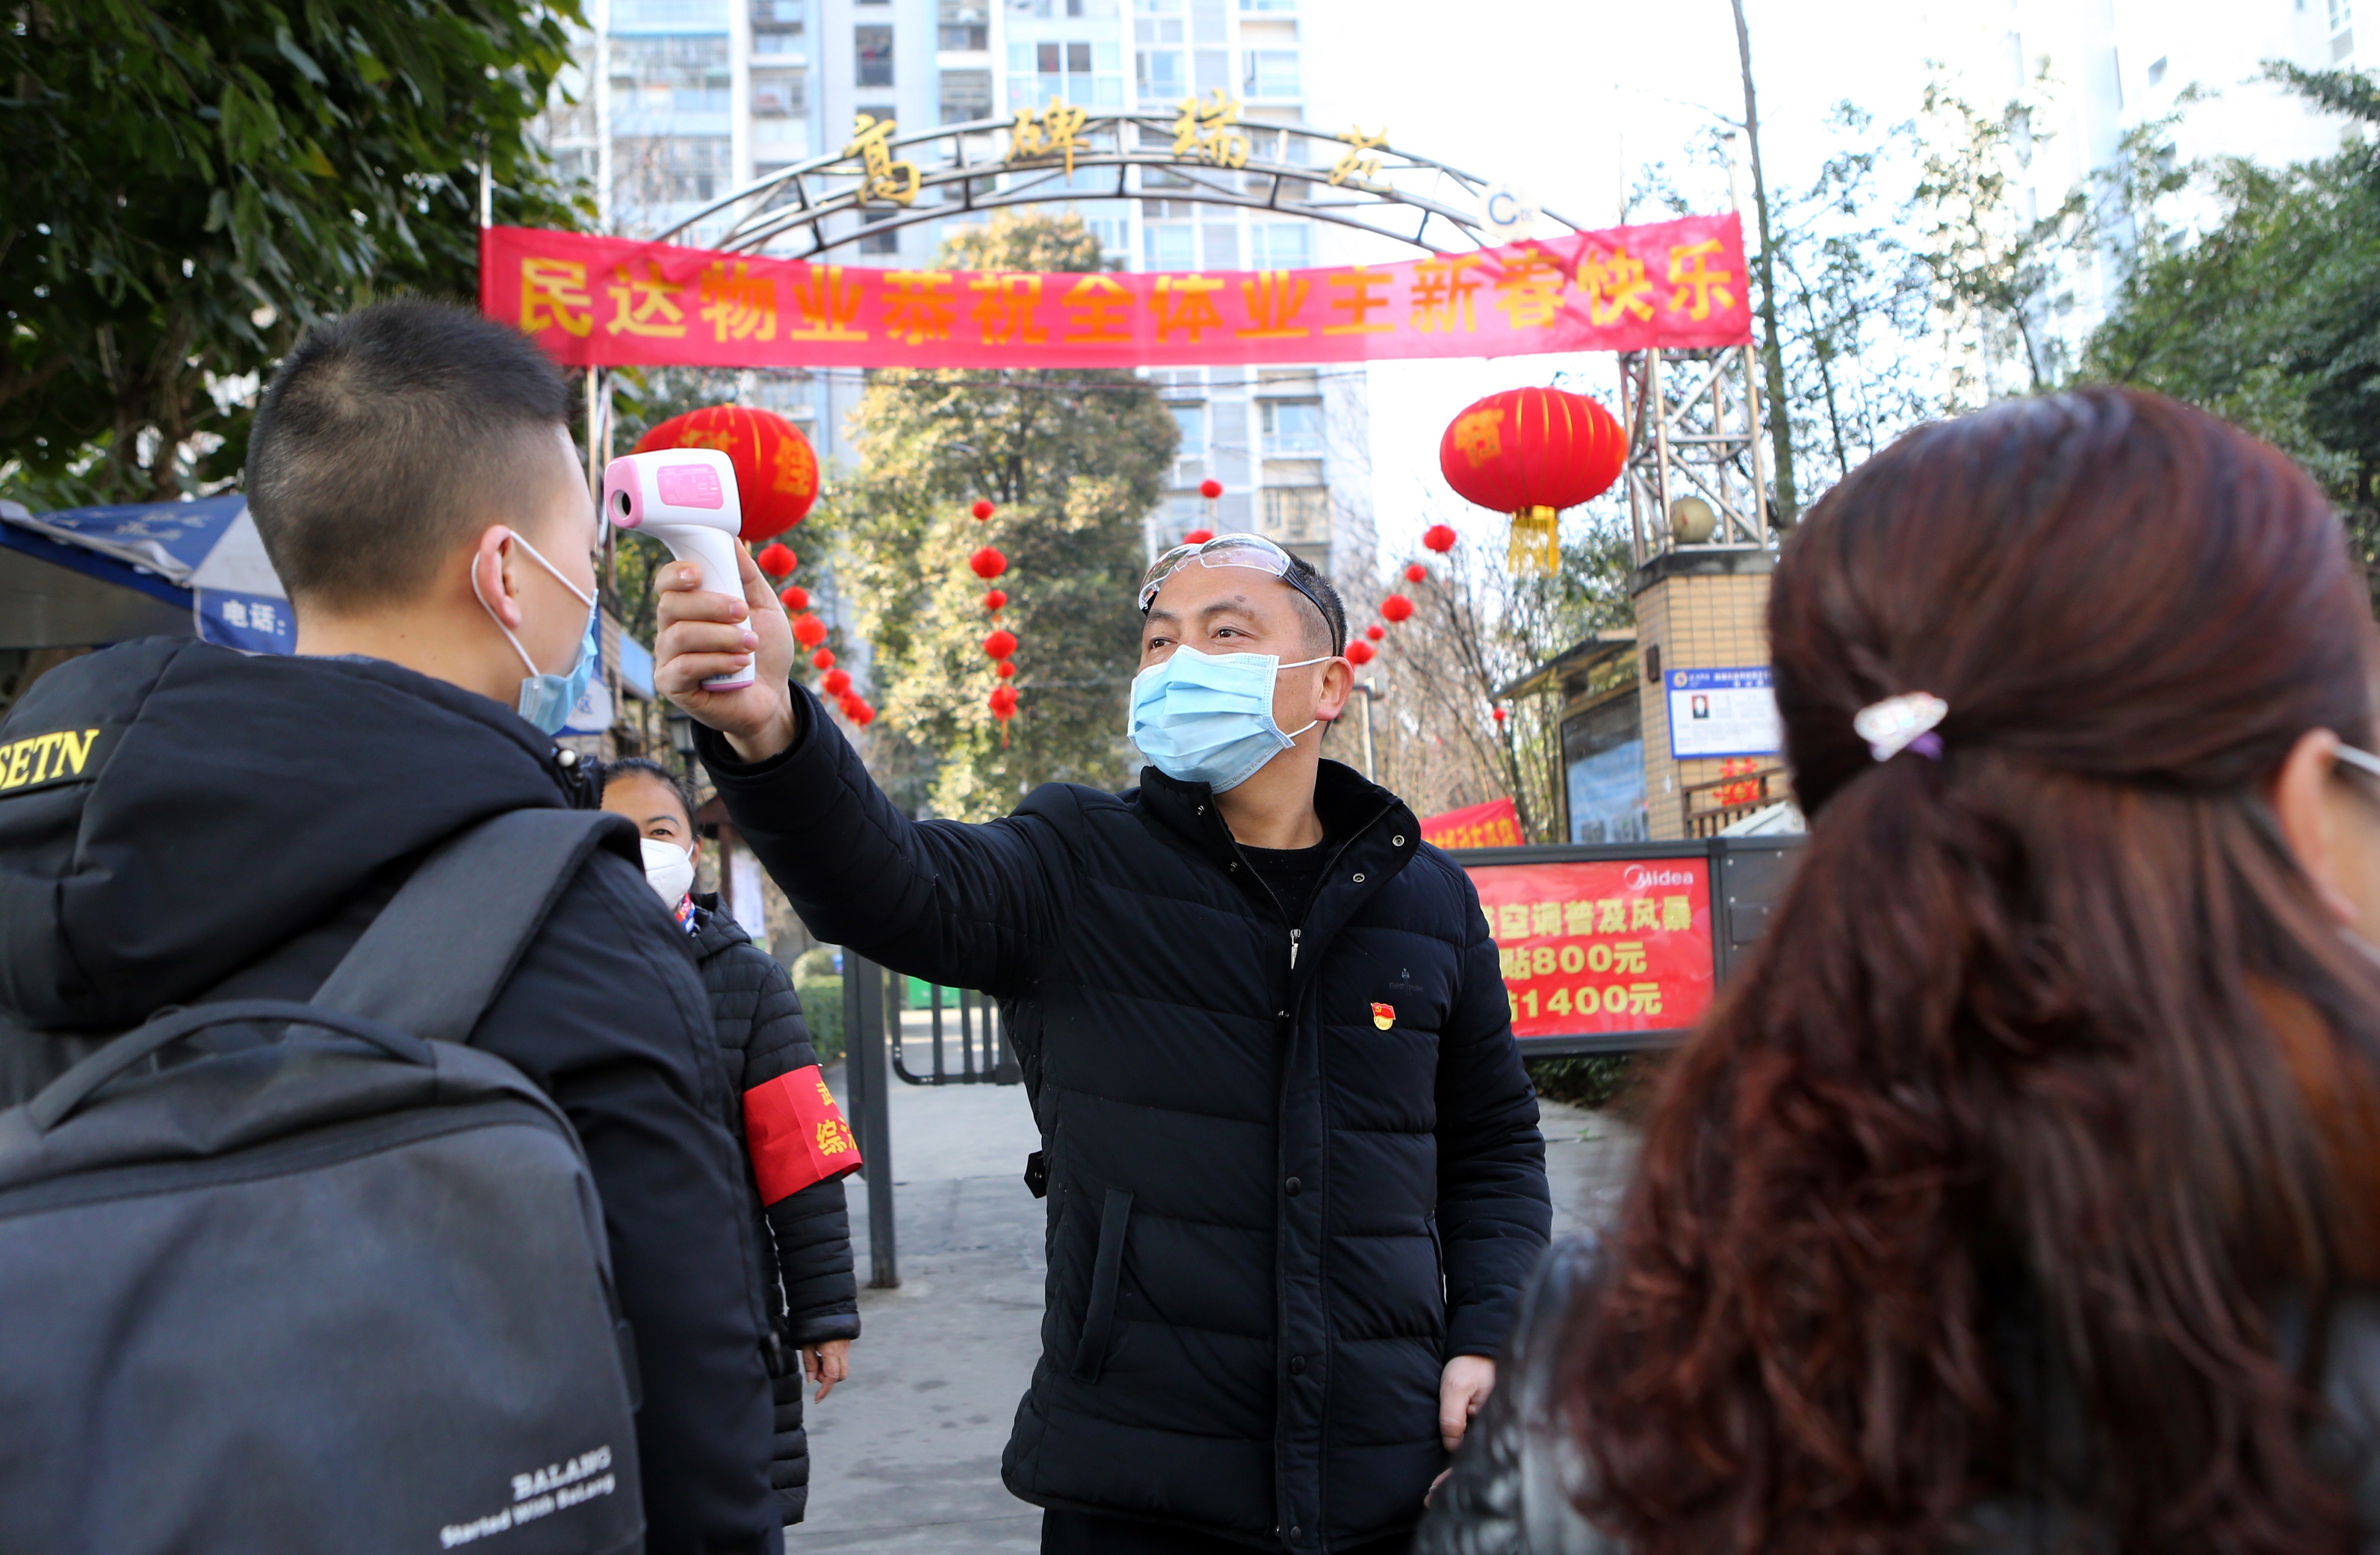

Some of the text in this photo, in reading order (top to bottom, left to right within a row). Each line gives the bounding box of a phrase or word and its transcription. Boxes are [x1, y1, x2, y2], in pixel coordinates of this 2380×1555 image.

[519, 237, 1737, 345] 民达物业恭祝全体业主新春快乐
[1628, 865, 1693, 890] Midea
